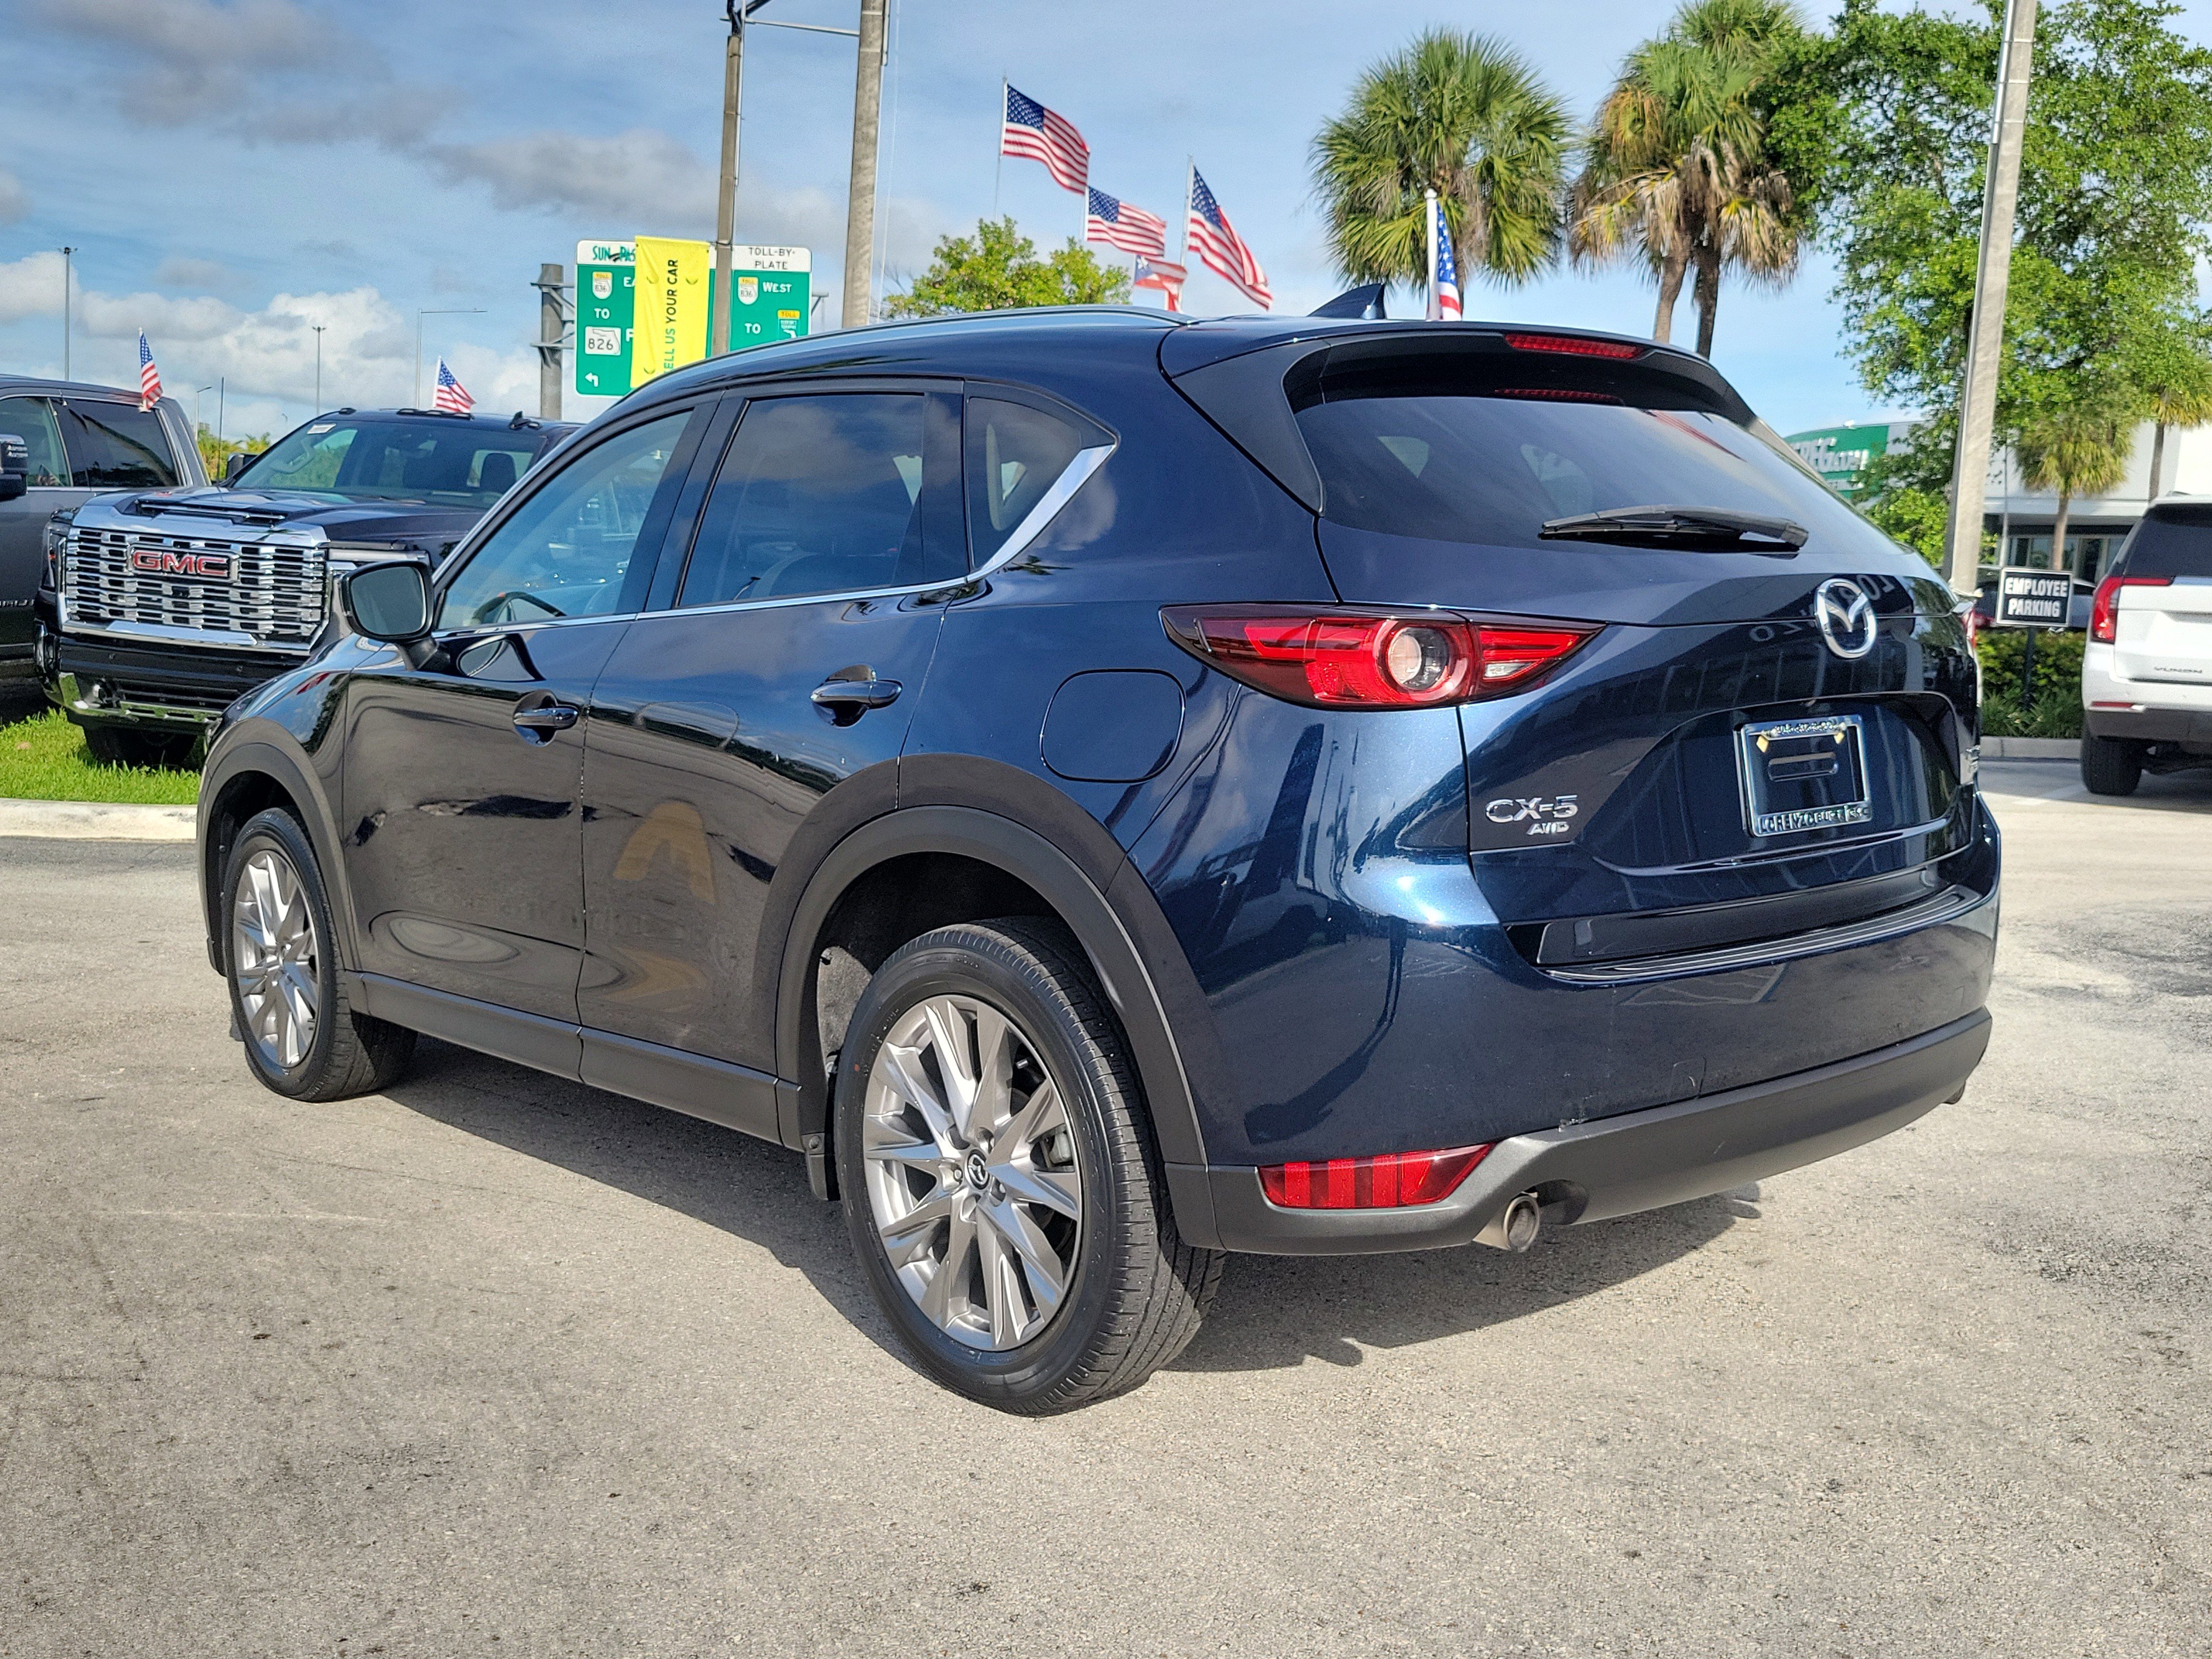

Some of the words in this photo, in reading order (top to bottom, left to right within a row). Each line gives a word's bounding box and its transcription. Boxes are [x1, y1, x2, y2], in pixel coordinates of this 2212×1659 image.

[620, 246, 636, 261] PAS
[667, 259, 678, 285] CAR
[755, 261, 788, 270] PLATE
[763, 281, 792, 293] WEST
[594, 308, 610, 319] TO
[666, 289, 678, 324] YOUR
[665, 328, 676, 344] US
[744, 323, 761, 334] TO
[588, 338, 614, 350] 826
[664, 348, 675, 374] ELL
[133, 550, 228, 577] GMC
[2005, 577, 2068, 597] EMPLOYEE
[2008, 597, 2061, 617] PARKING
[1485, 795, 1578, 823] CX-5
[1526, 821, 1570, 836] AWD
